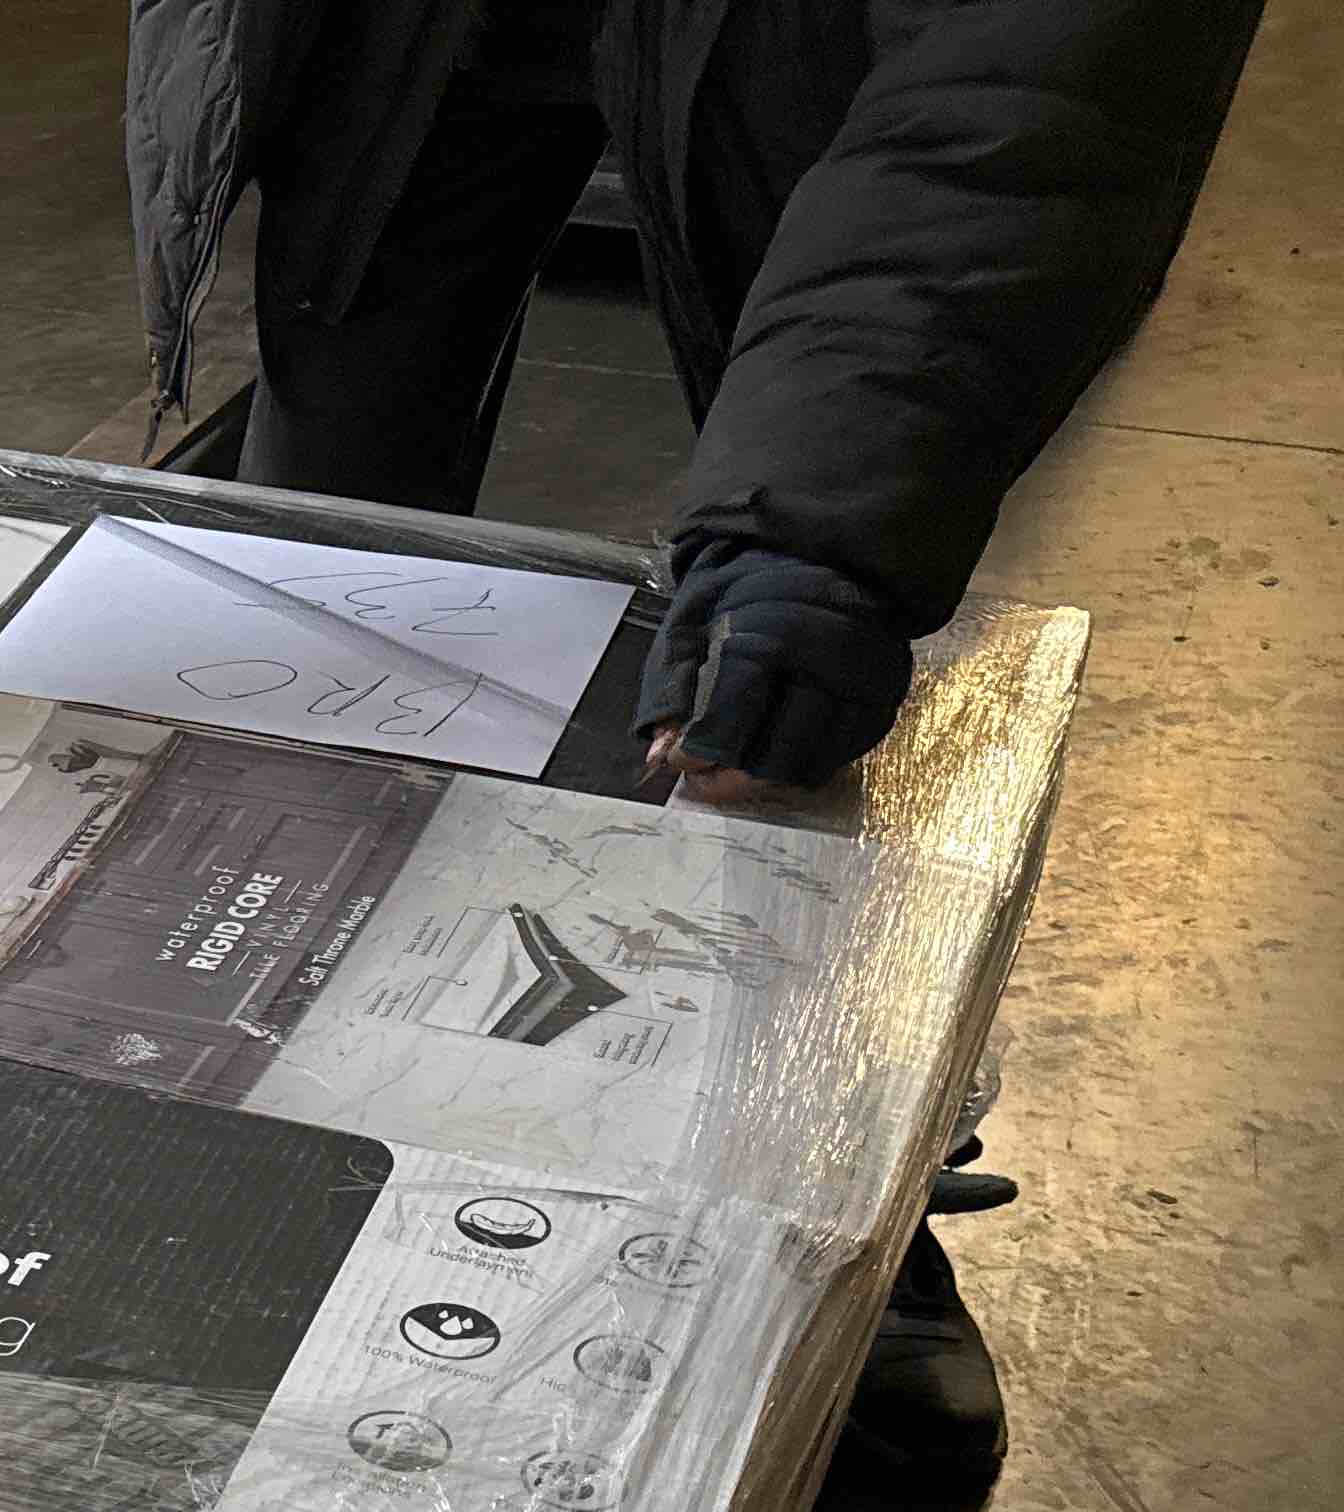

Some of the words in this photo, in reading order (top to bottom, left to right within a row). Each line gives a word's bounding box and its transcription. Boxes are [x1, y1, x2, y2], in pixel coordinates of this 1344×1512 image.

[155, 864, 243, 963] waterproof
[186, 913, 246, 973] RIGID
[228, 872, 284, 921] CORE
[364, 1344, 405, 1363] 100%
[408, 1353, 497, 1386] Waterproof
